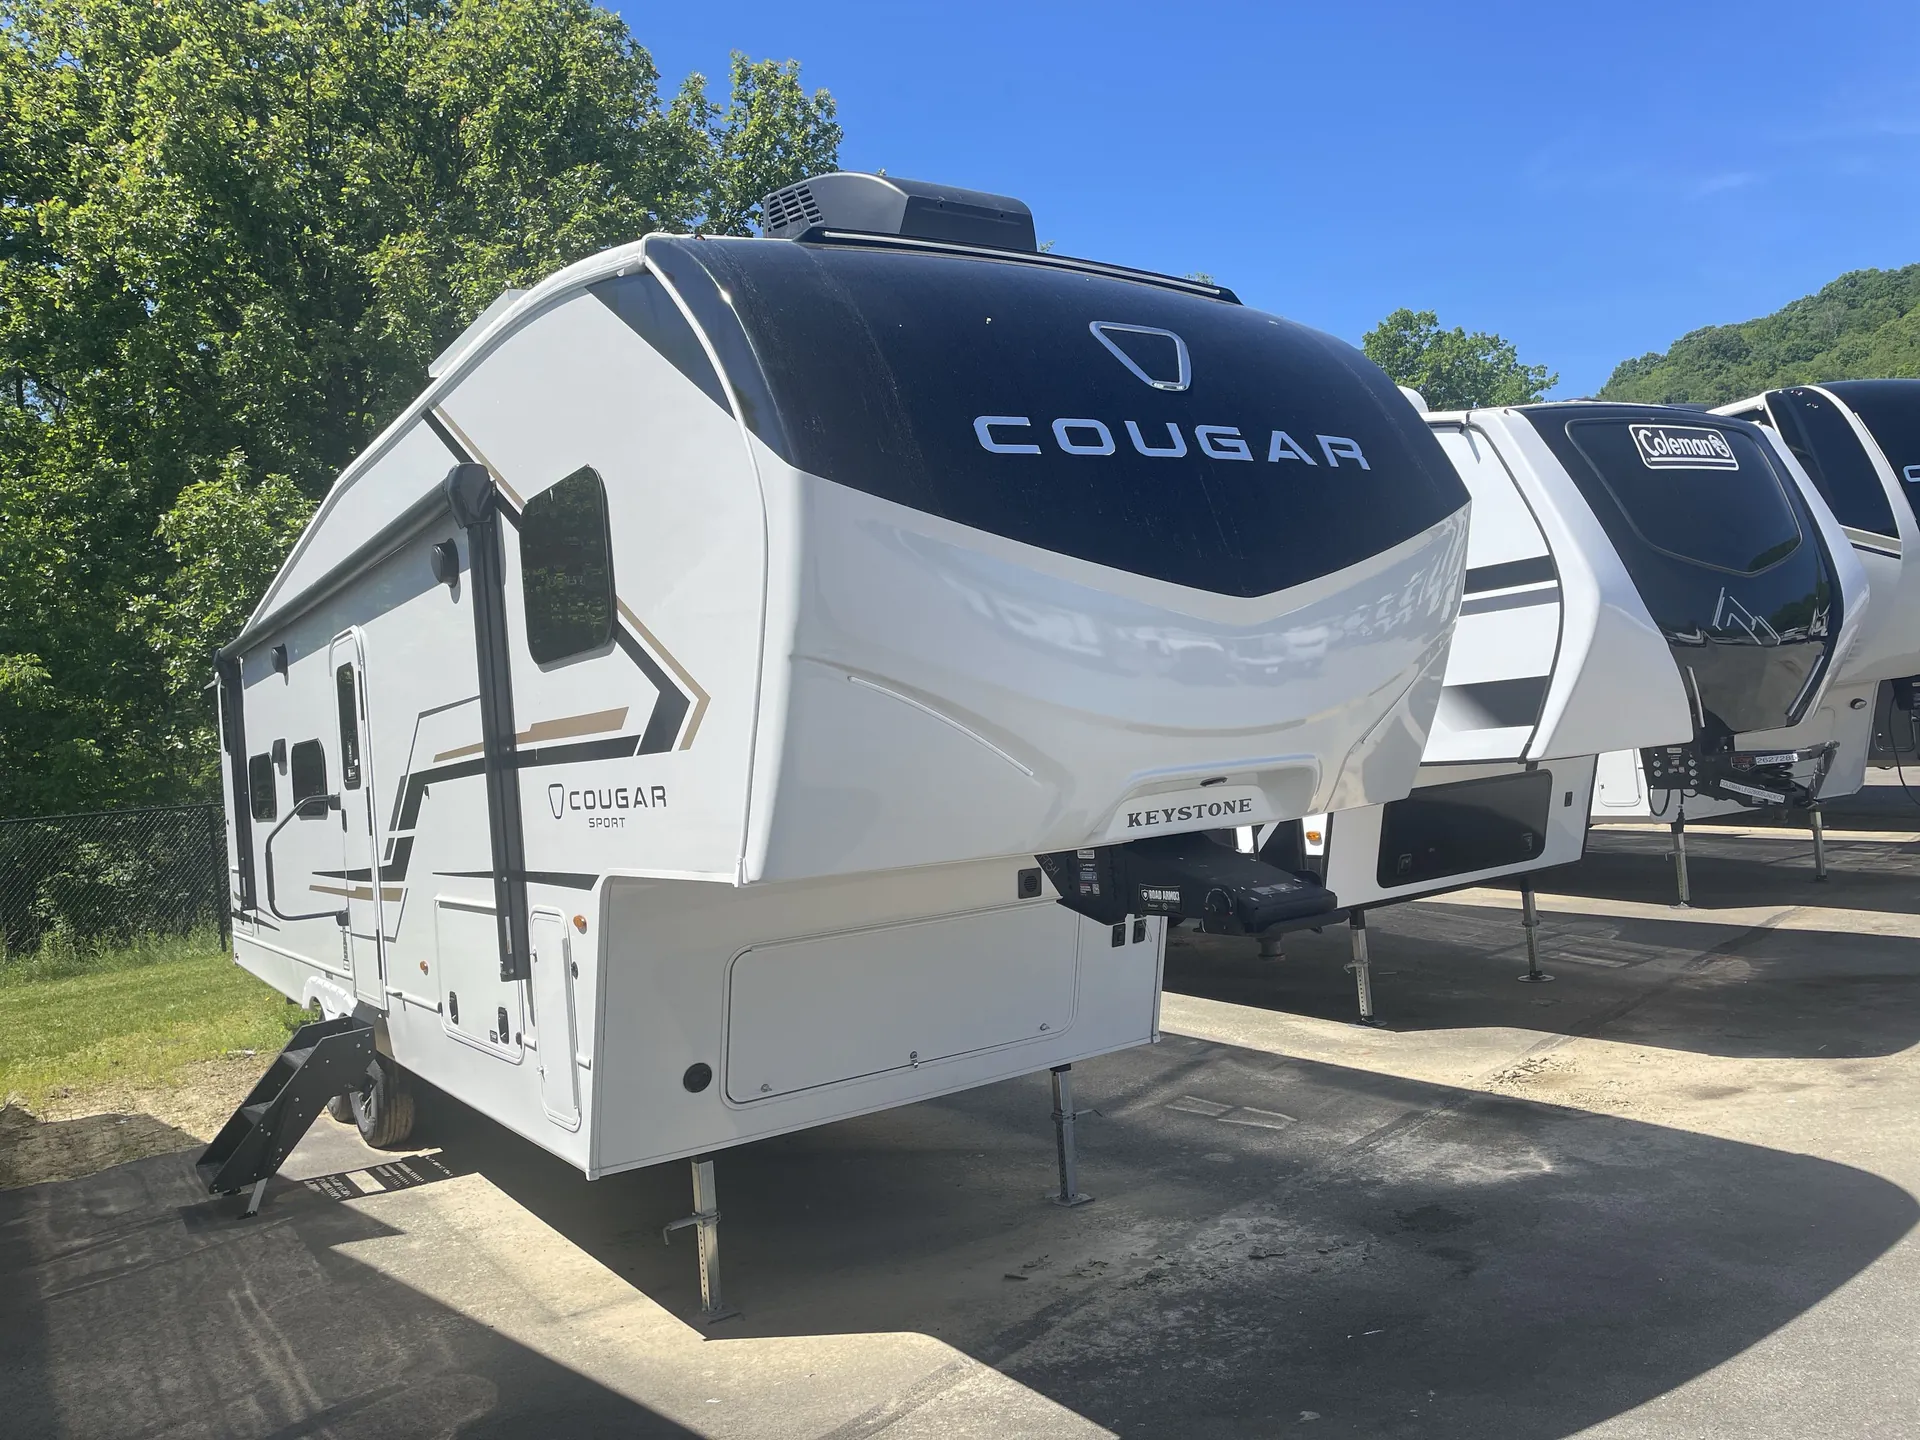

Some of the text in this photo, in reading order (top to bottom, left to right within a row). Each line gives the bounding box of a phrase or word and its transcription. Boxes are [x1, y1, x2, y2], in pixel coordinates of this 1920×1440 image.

[973, 415, 1371, 470] COUGAR
[1638, 429, 1717, 457] Coleman
[569, 785, 667, 810] COUGAR
[588, 817, 626, 828] SPORT
[1127, 798, 1252, 828] KEYSTONE
